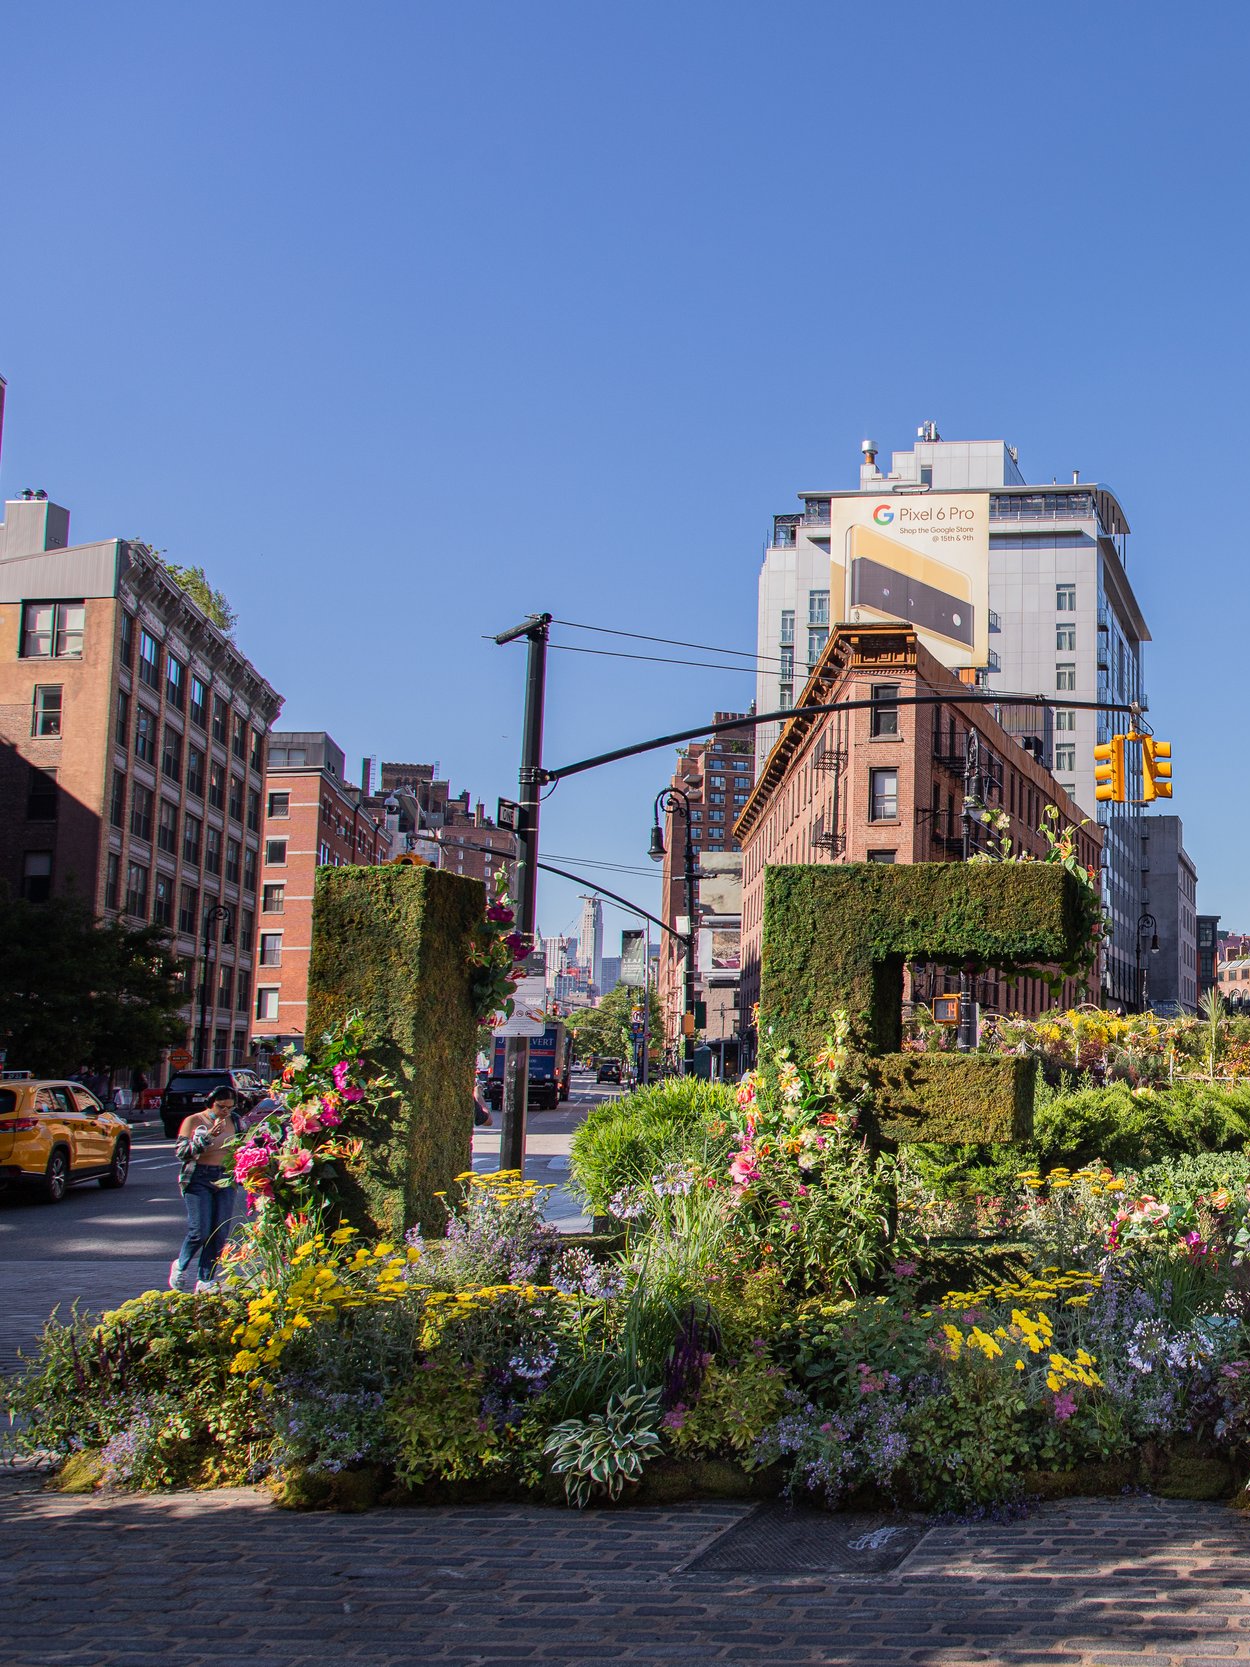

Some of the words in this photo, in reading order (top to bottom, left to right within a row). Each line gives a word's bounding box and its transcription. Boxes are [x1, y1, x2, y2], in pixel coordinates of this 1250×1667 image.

[899, 508, 933, 521] Pixel
[936, 507, 946, 521] 6
[949, 507, 975, 520] Pro
[899, 527, 917, 535] Shop
[930, 526, 955, 534] Google
